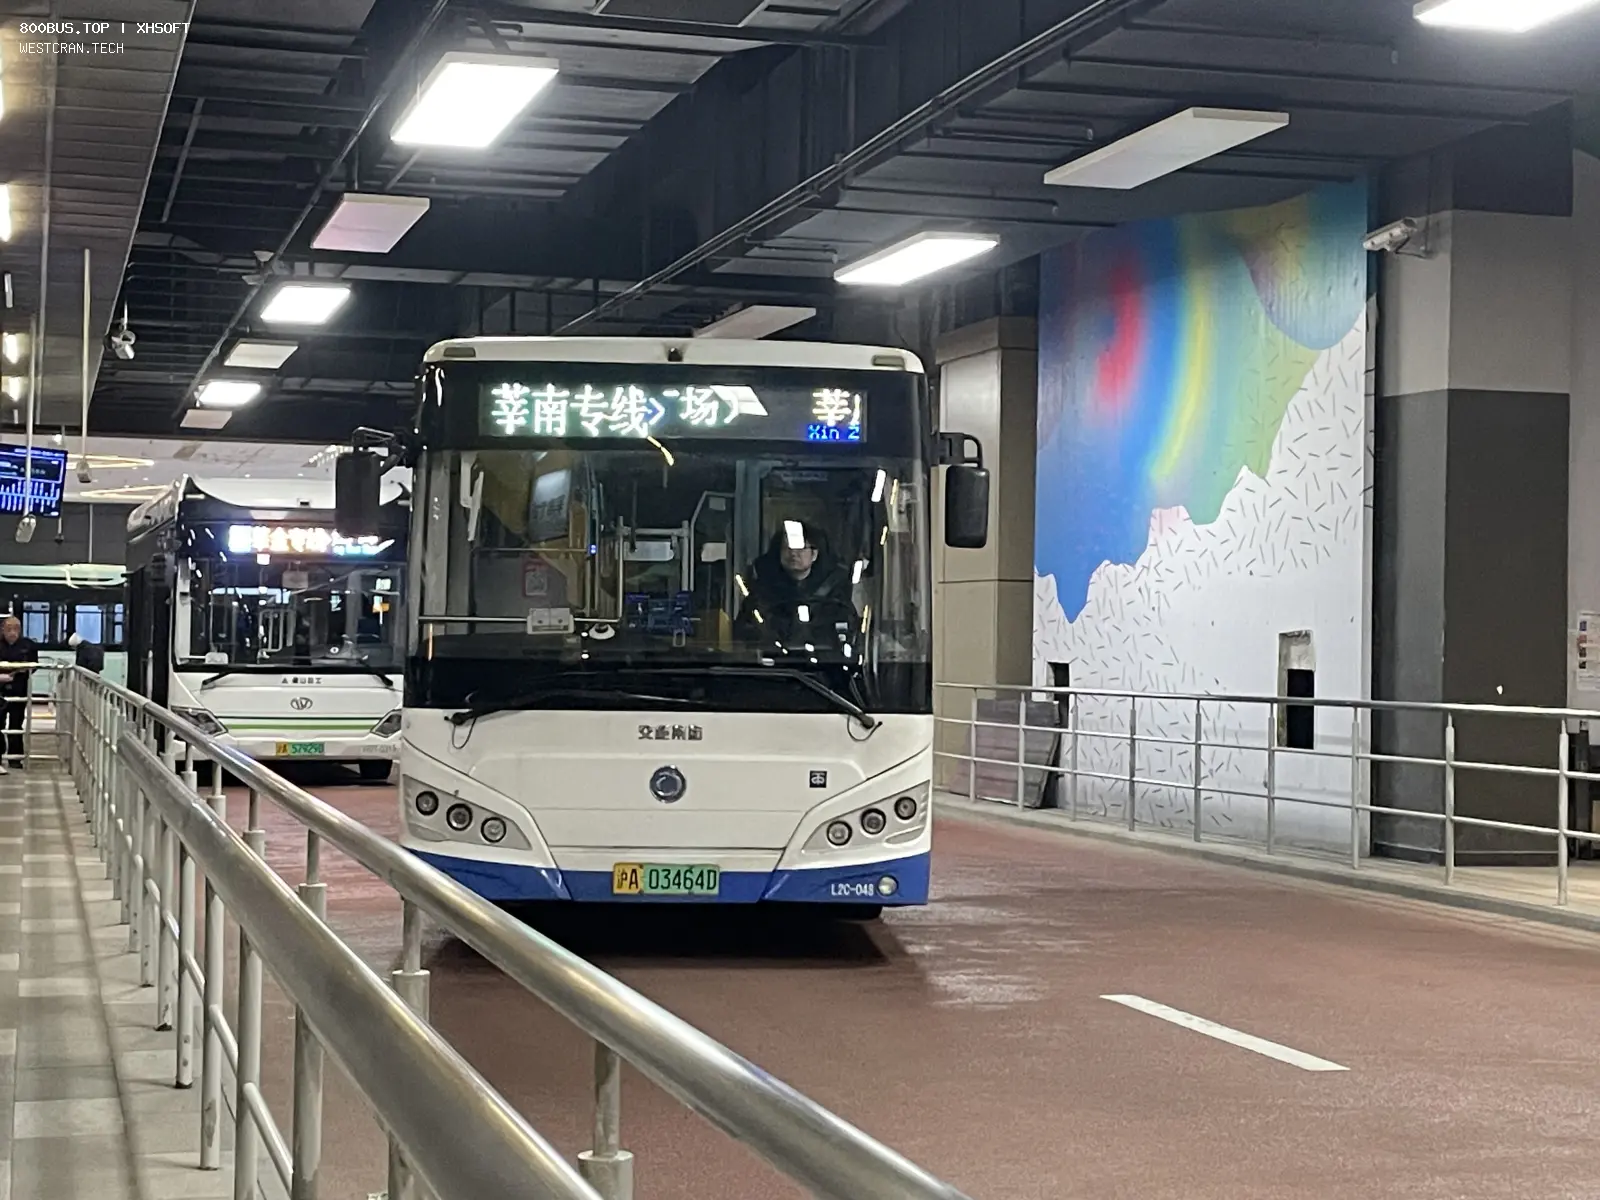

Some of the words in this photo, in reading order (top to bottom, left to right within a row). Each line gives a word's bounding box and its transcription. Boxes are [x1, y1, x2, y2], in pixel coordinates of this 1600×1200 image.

[491, 382, 650, 437] 莘南专线
[811, 387, 861, 427] 莘
[808, 423, 840, 440] Xin
[648, 868, 718, 891] 03464D
